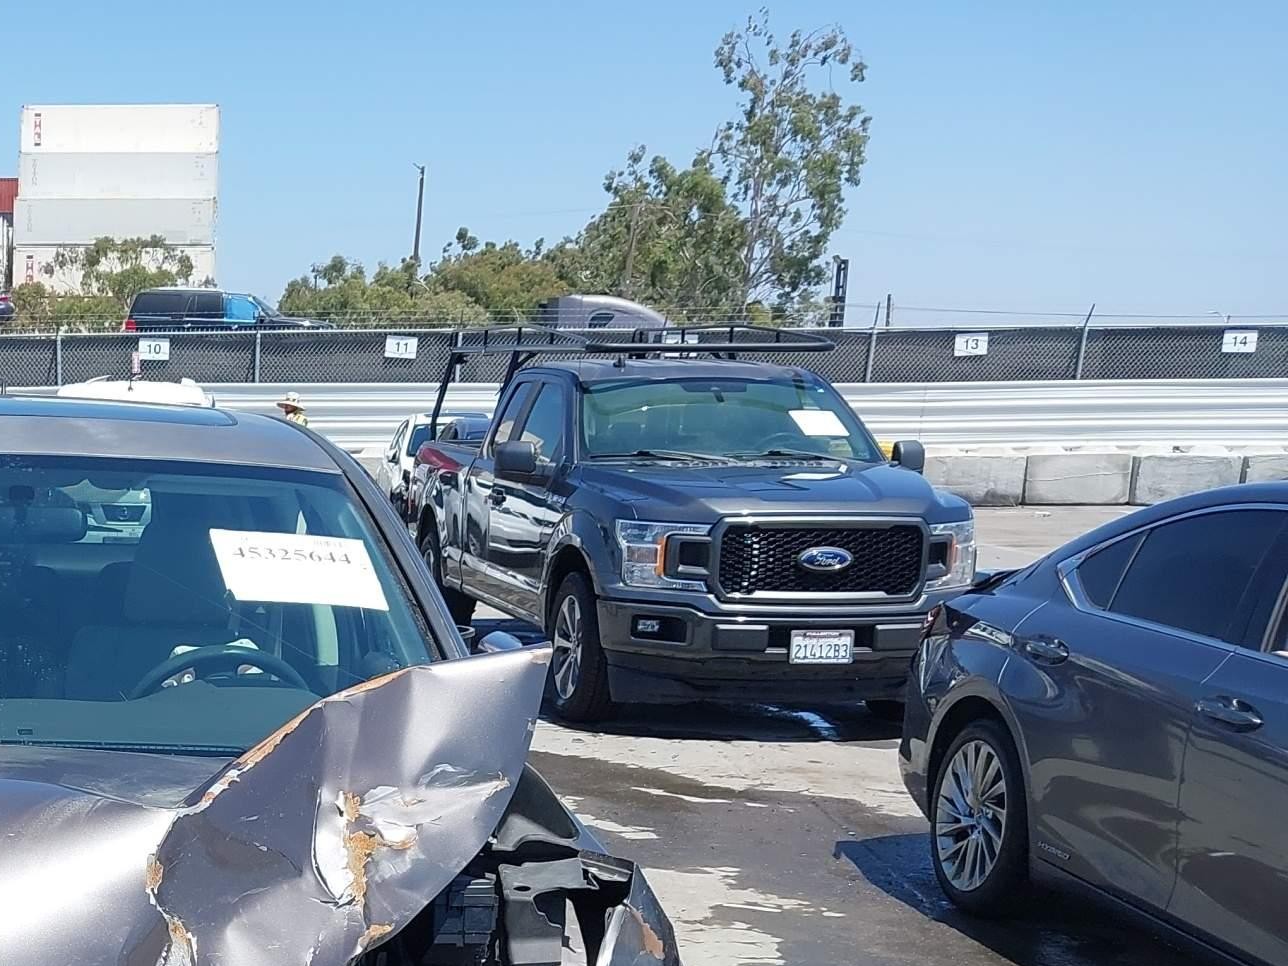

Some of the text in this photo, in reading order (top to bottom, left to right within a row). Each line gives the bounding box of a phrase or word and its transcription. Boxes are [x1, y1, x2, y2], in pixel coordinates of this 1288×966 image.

[963, 338, 979, 350] 13
[1232, 335, 1248, 347] 14
[147, 343, 161, 355] 10
[395, 342, 409, 353] 11
[232, 546, 352, 564] 45325644
[814, 551, 842, 566] Ford
[794, 643, 849, 660] 21412B3
